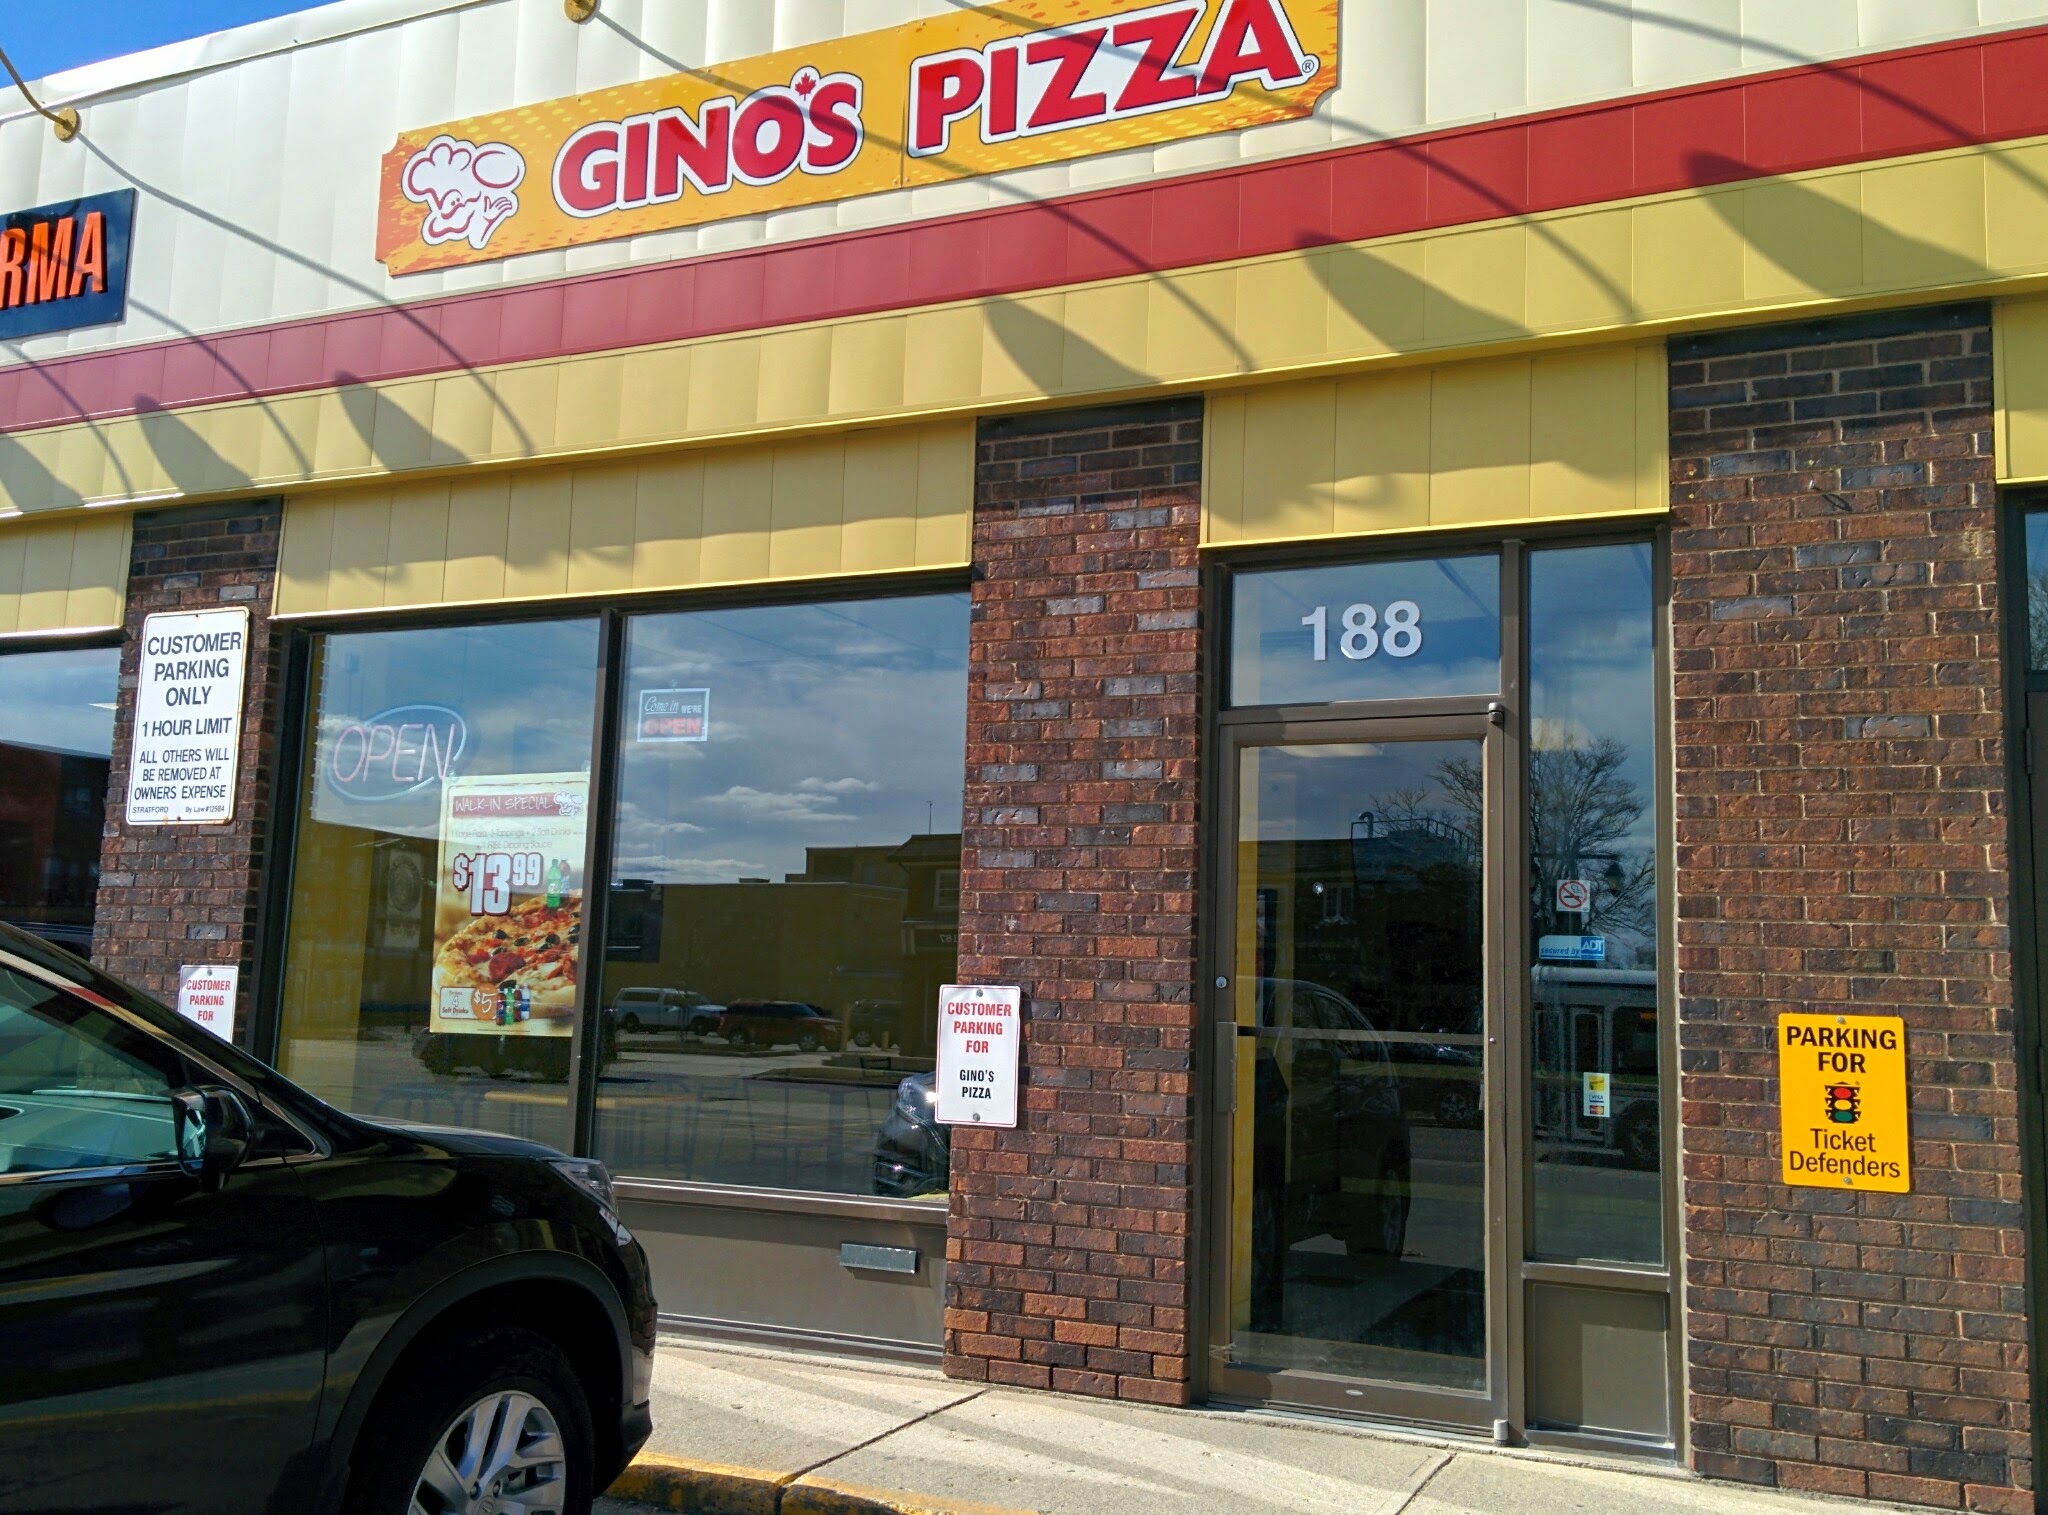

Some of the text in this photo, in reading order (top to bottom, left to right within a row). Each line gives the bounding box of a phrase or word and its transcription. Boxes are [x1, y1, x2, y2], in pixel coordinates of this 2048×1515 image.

[914, 0, 1304, 151] PIZZA
[1301, 599, 1423, 661] 188
[147, 631, 242, 656] CUSTOMER
[154, 658, 230, 682] PARKING
[165, 686, 212, 707] ONLY
[644, 695, 668, 711] Come
[669, 699, 680, 712] in
[142, 717, 233, 737] 1 HOUR LIMIT
[642, 717, 703, 735] OPEN
[139, 747, 230, 764] ALL OTHERS WILL
[333, 723, 456, 783] OPEN
[142, 766, 222, 782] BE REMOVED AT
[134, 785, 226, 800] OWNERS EXPENSE
[132, 806, 169, 814] STRATFORD
[455, 795, 553, 812] WALK-IN SPECIAL
[1541, 946, 1580, 956] secured by
[1581, 939, 1605, 952] ADT
[186, 979, 231, 991] CUSTOMER
[189, 995, 225, 1006] PARKING
[473, 989, 497, 1014] $5
[197, 1010, 214, 1021] FOR
[947, 1002, 1012, 1017] CUSTOMER
[953, 1020, 1003, 1035] PARKING
[1786, 1026, 1897, 1050] PARKING
[965, 1040, 989, 1054] FOR
[1817, 1052, 1867, 1074] FOR
[959, 1069, 995, 1083] GINO'S
[961, 1086, 992, 1100] PIZZA
[1810, 1128, 1877, 1153] Ticket
[1789, 1150, 1901, 1179] Defenders
